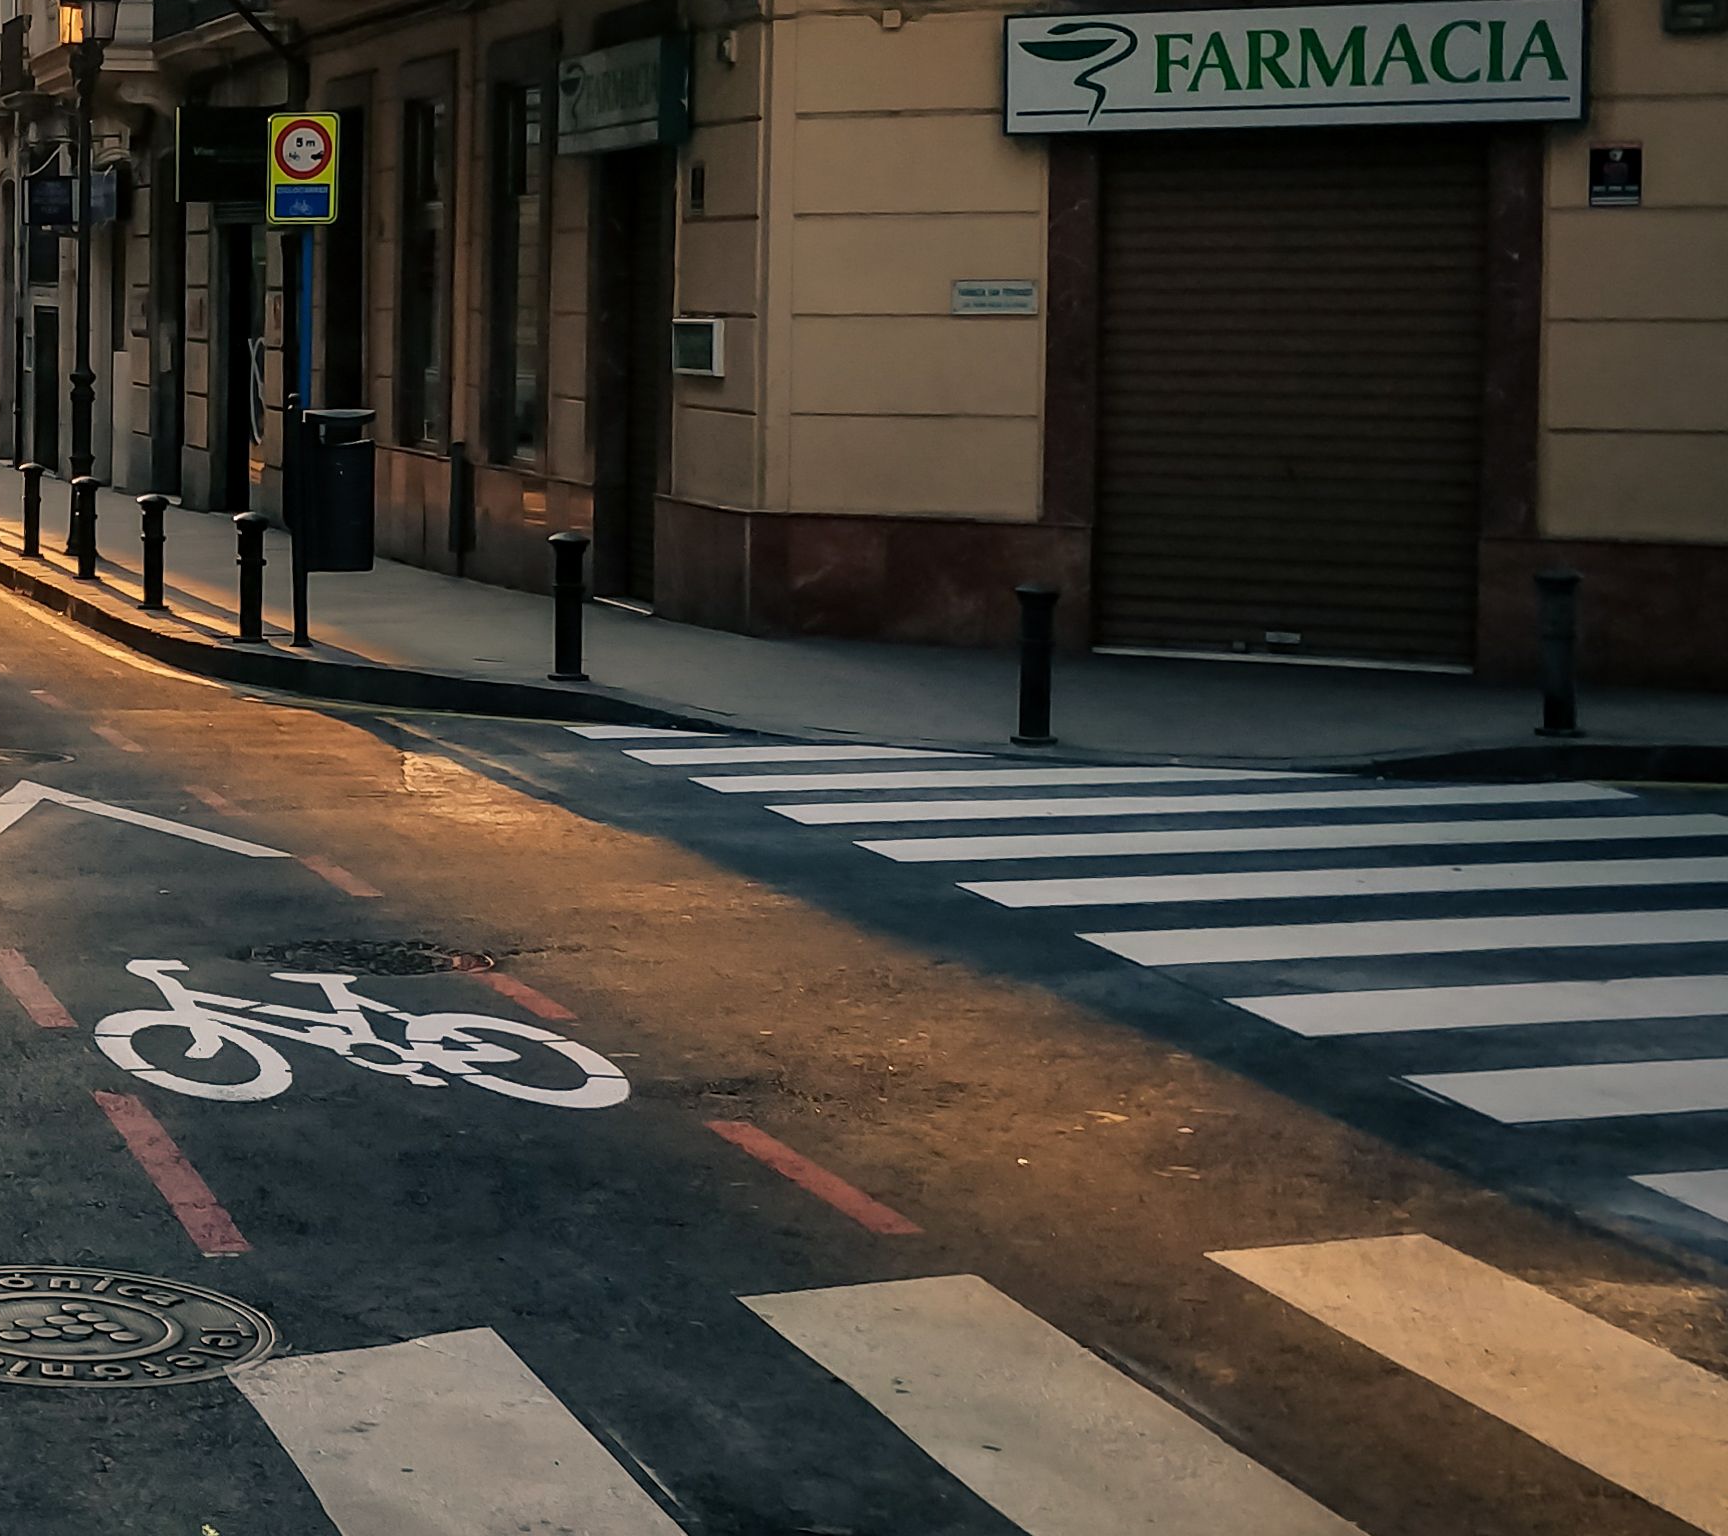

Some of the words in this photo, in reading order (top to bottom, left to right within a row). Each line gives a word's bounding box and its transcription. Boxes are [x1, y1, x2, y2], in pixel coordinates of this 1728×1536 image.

[1153, 19, 1569, 94] FARMACIA
[295, 137, 303, 148] 5
[306, 139, 316, 148] m
